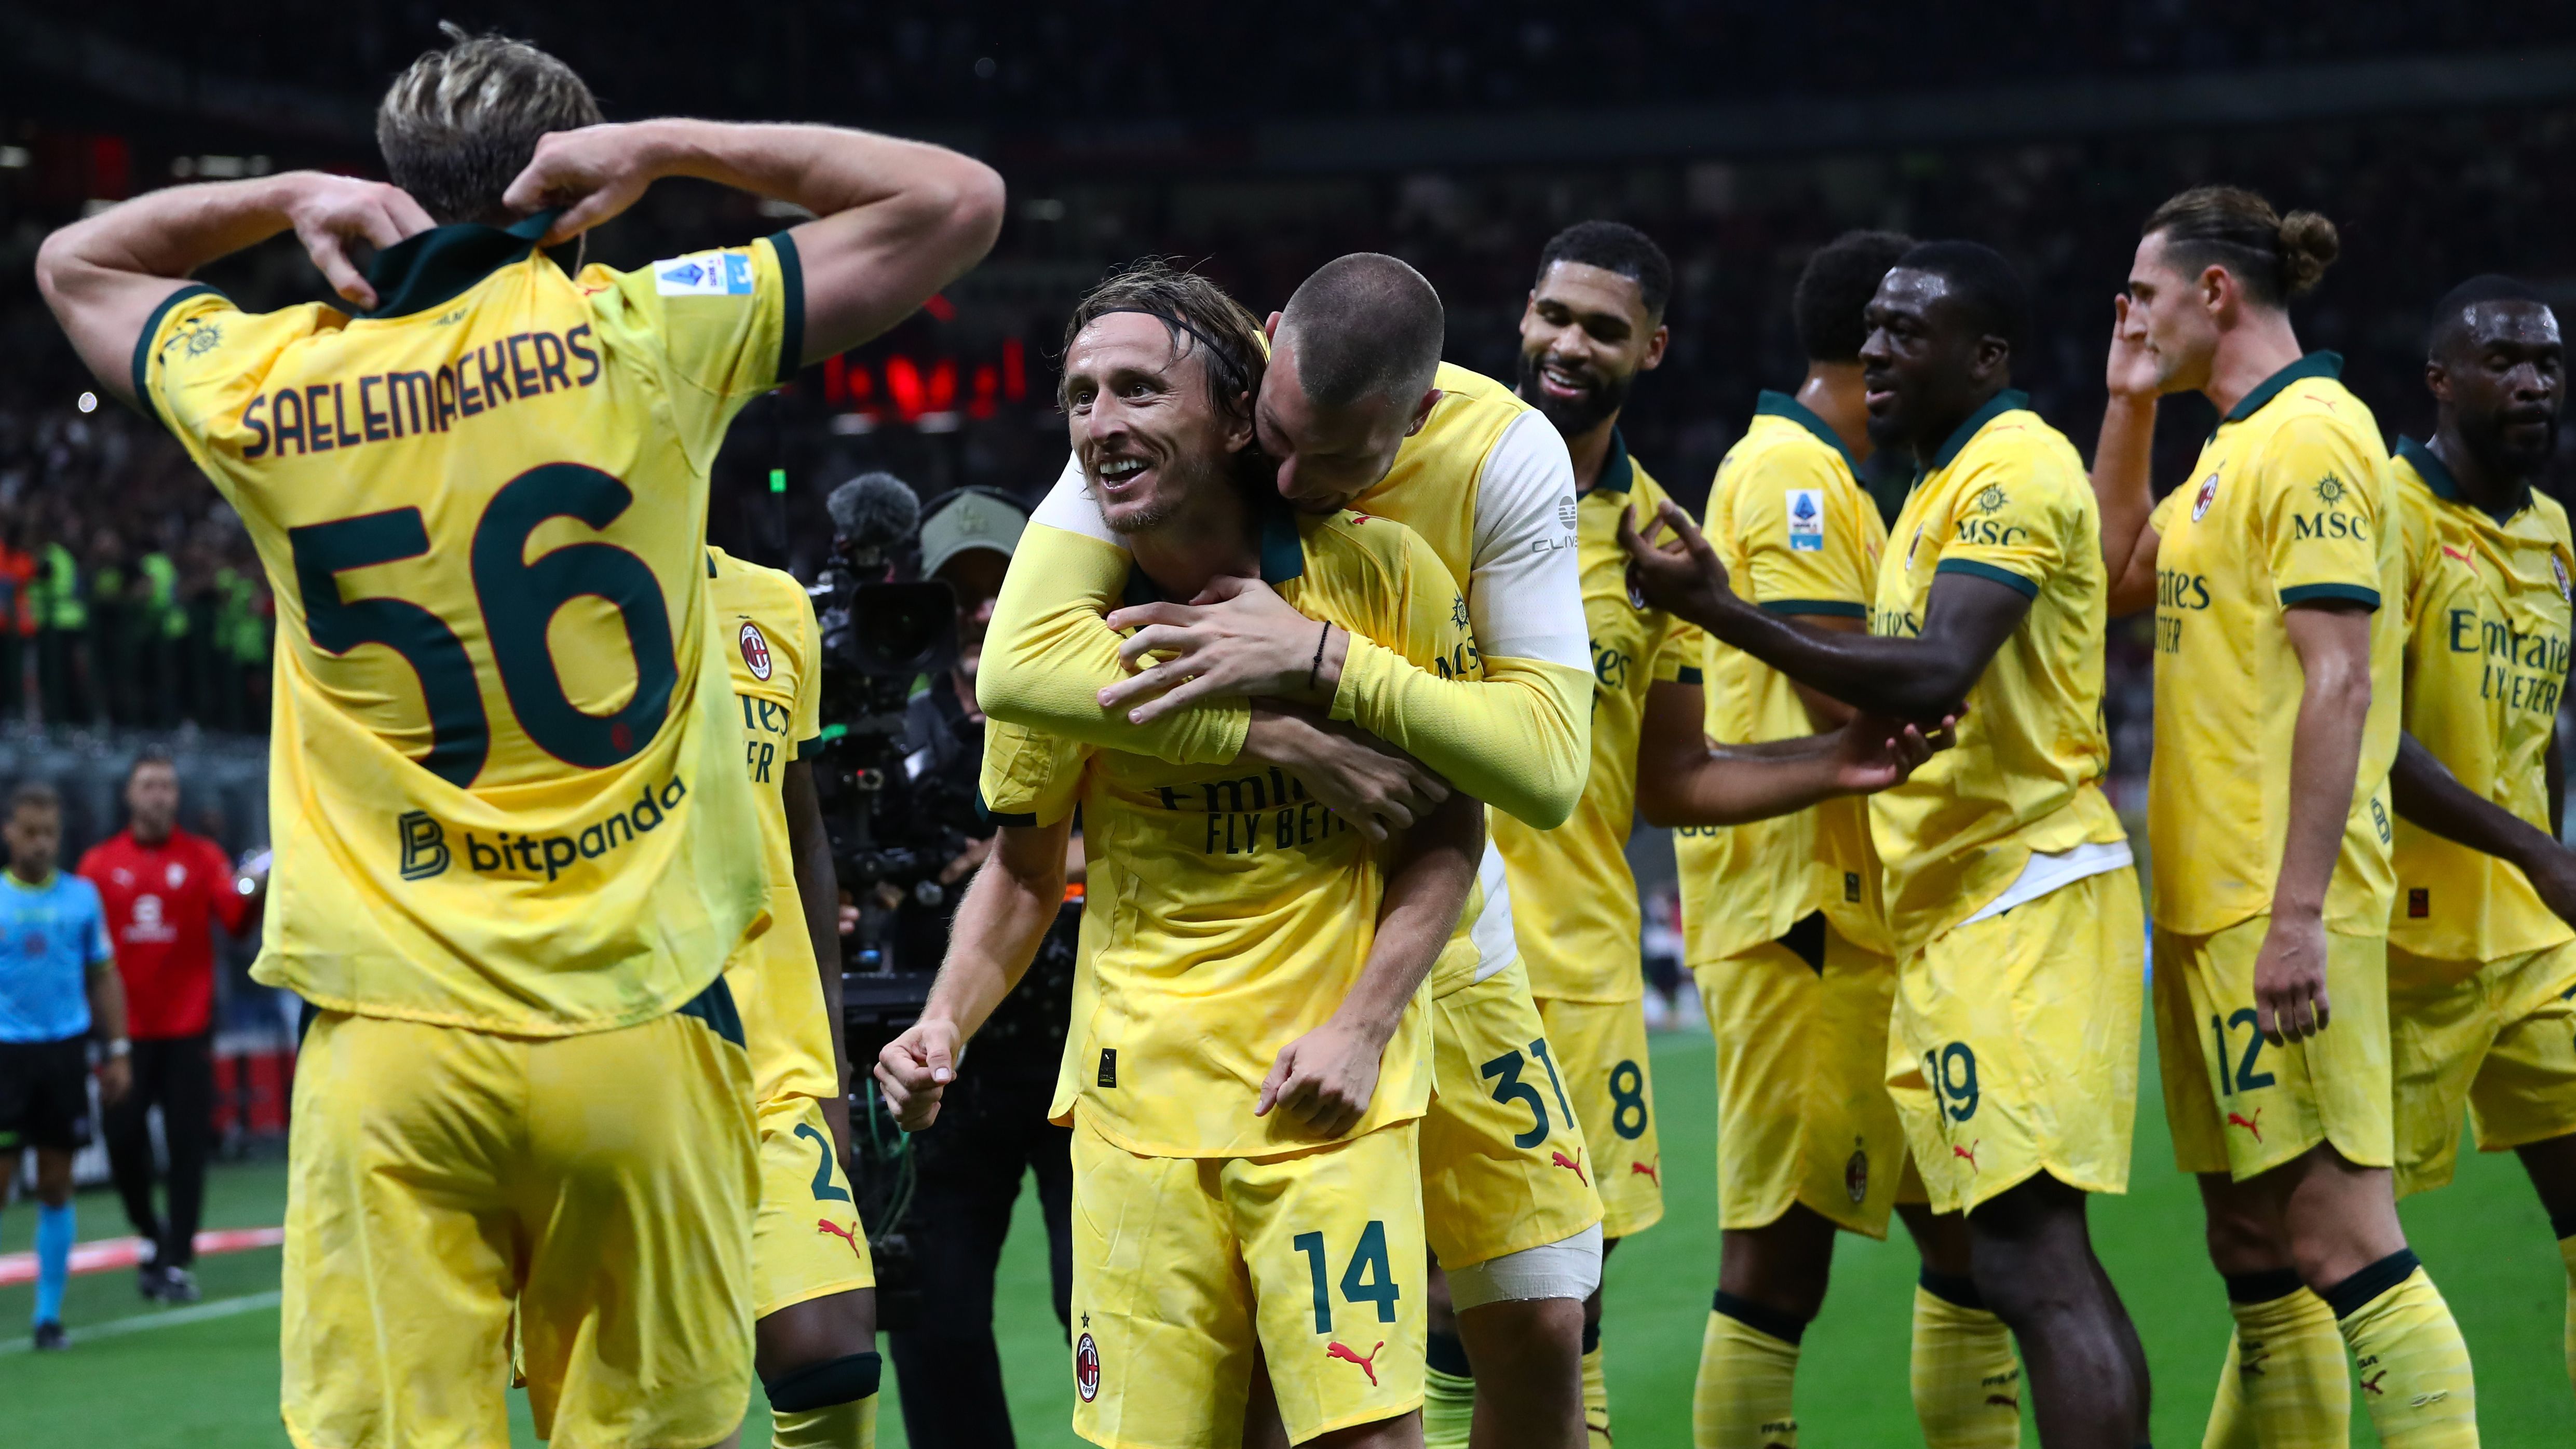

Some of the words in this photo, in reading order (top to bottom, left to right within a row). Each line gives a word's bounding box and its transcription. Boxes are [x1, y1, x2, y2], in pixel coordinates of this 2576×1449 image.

[242, 323, 601, 459] SAELEMAEKERS
[1956, 519, 2027, 546] MSC
[2293, 511, 2367, 541] MSC
[289, 462, 679, 789] 56
[466, 775, 687, 882] bitpanda
[1206, 813, 1261, 855] FLY
[1480, 1037, 1575, 1149] 31
[1926, 1041, 1980, 1128] 19
[2212, 1008, 2276, 1096] 12
[1609, 1060, 1648, 1140] 8
[793, 1122, 851, 1203] 2
[1293, 1221, 1400, 1334] 14
